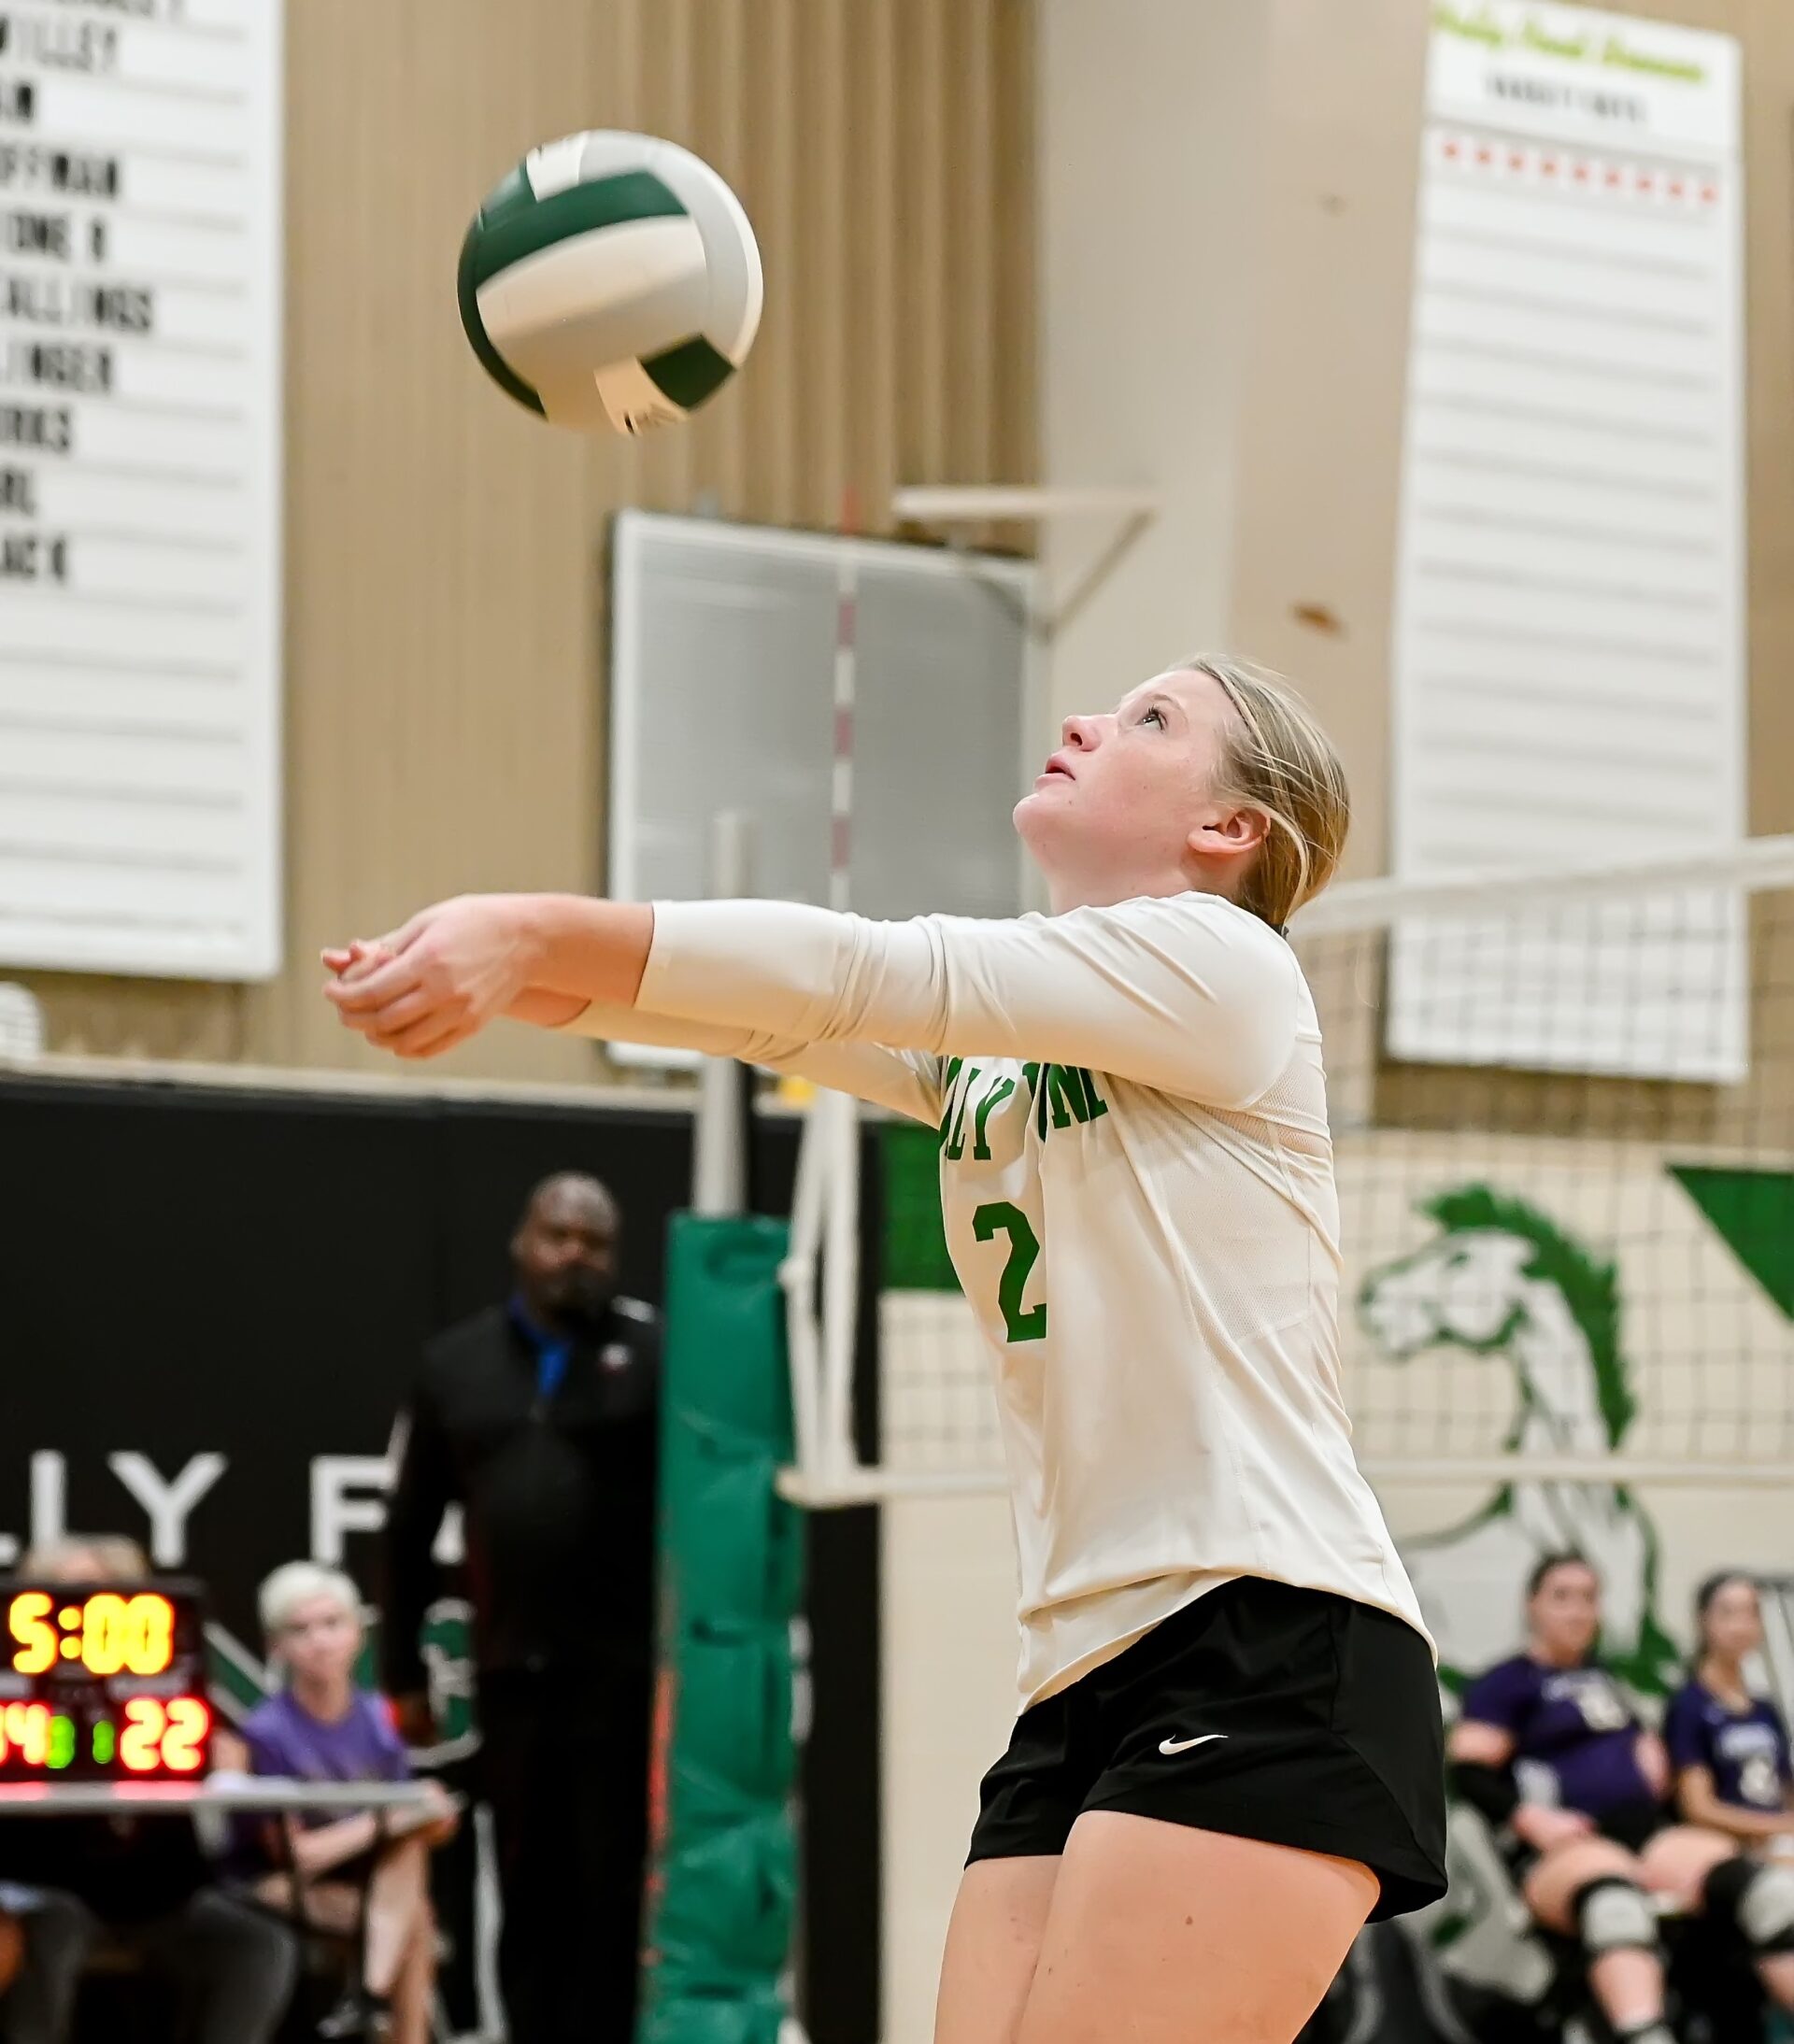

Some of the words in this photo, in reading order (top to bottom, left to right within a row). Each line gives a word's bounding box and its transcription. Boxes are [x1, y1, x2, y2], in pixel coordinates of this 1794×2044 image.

[973, 1201, 1046, 1342] 2
[9, 1591, 174, 1675] 5:00
[120, 1696, 209, 1771] 22
